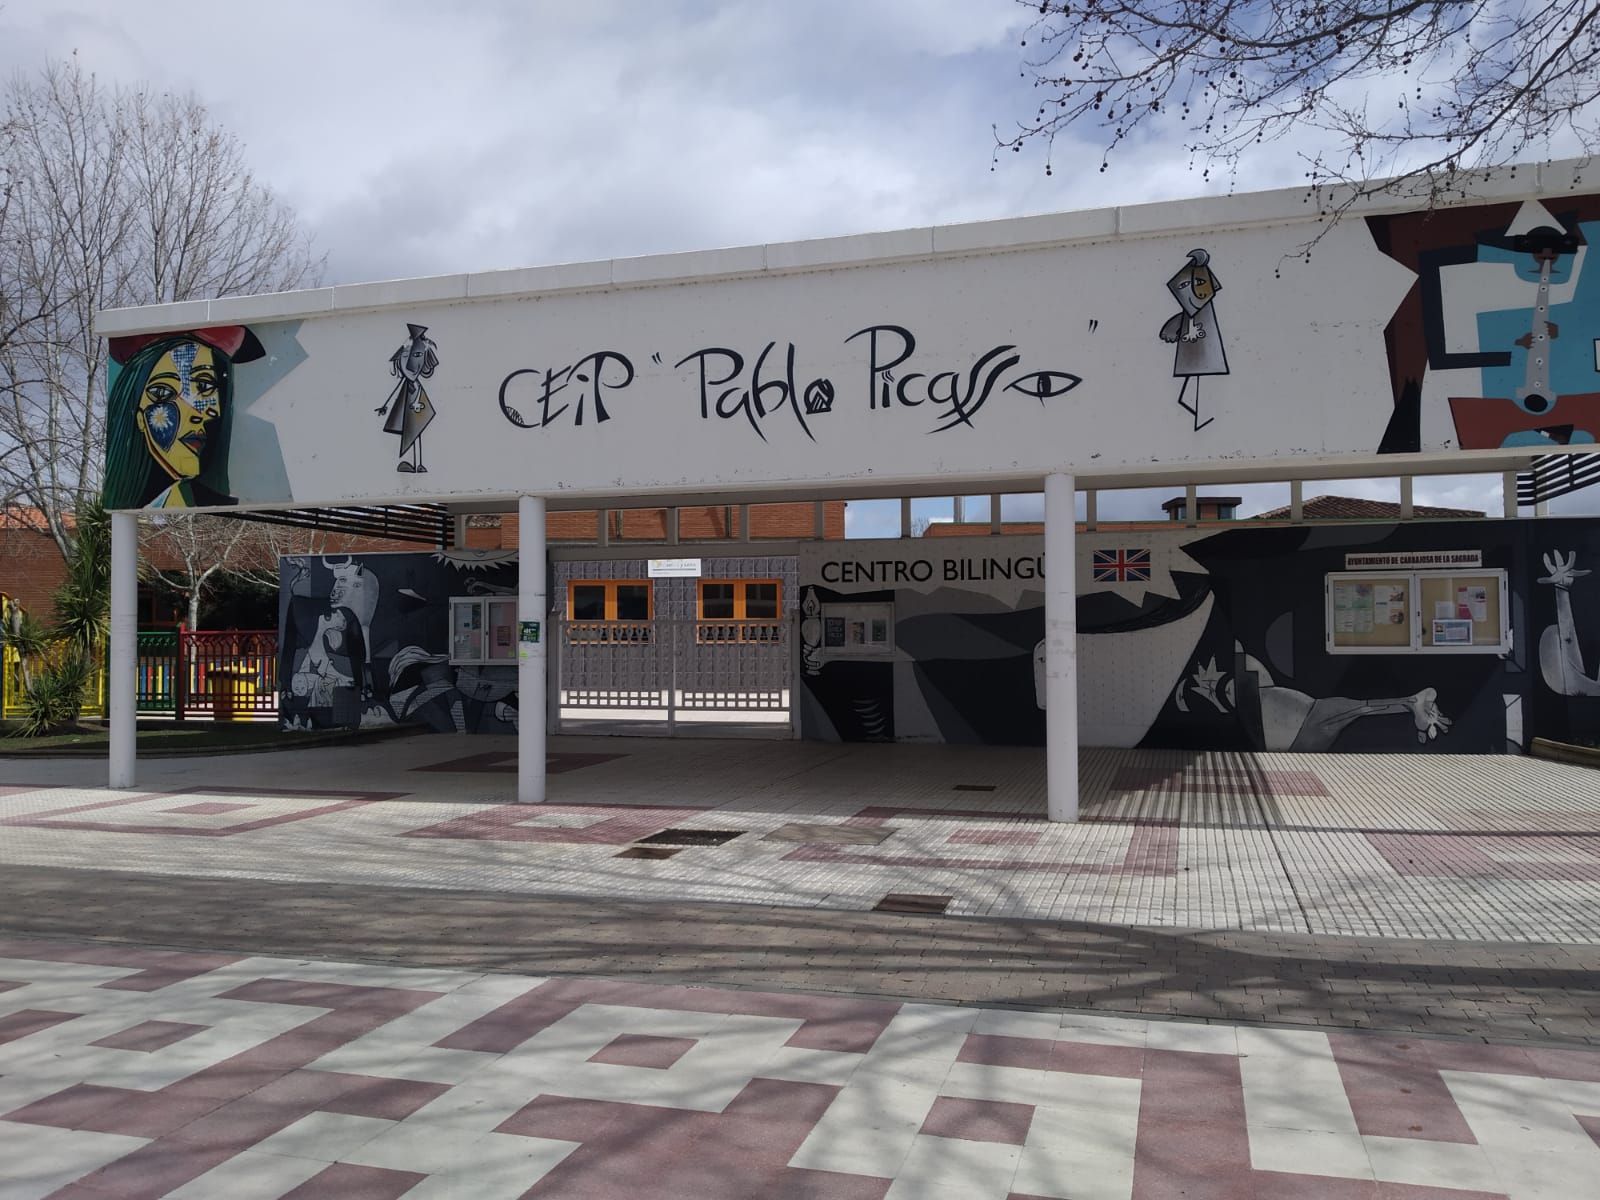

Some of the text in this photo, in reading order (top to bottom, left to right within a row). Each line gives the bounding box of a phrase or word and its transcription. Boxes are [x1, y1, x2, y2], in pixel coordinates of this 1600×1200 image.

[1391, 556, 1398, 564] DE
[1435, 554, 1442, 562] DE
[1443, 554, 1450, 562] LA
[821, 560, 933, 583] CENTRO
